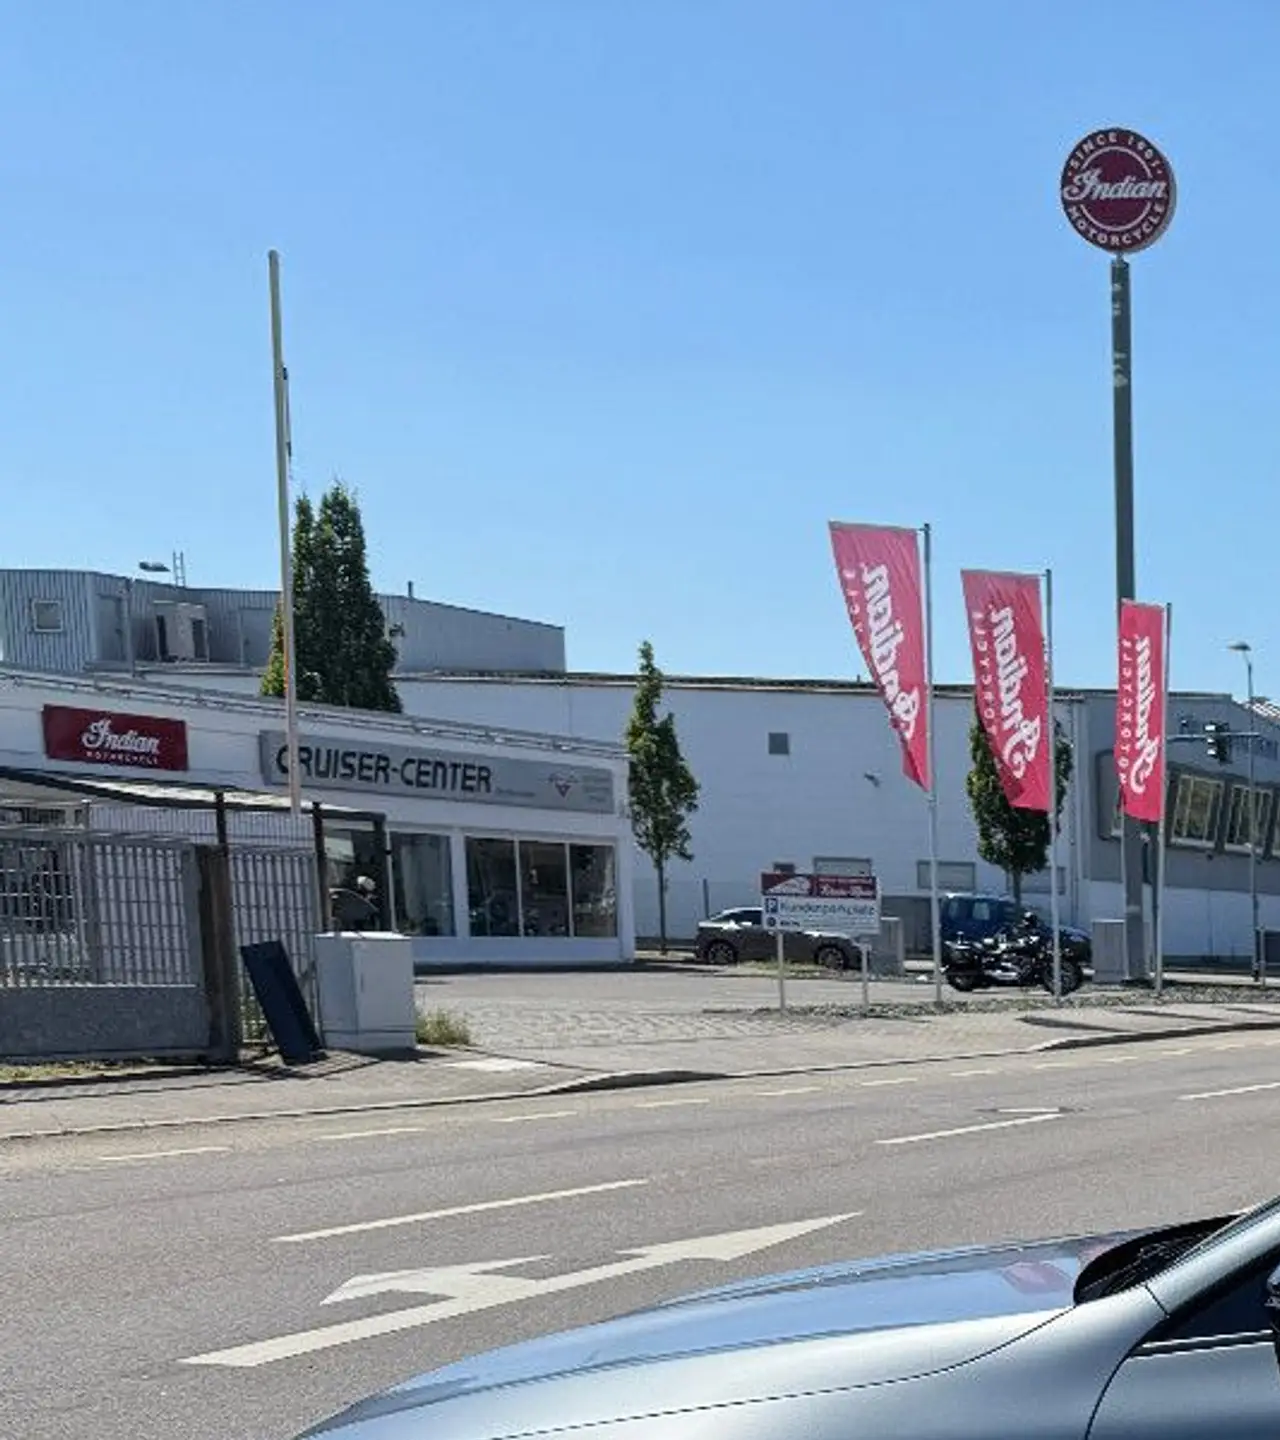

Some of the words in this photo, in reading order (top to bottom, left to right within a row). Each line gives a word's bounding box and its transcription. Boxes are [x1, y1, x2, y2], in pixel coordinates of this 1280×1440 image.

[1070, 132, 1118, 170] SINCE
[1063, 167, 1168, 201] Indian
[1067, 203, 1165, 246] MOTORCYCLE
[81, 718, 160, 754] Indian
[275, 745, 495, 794] CRUISER-CENTER
